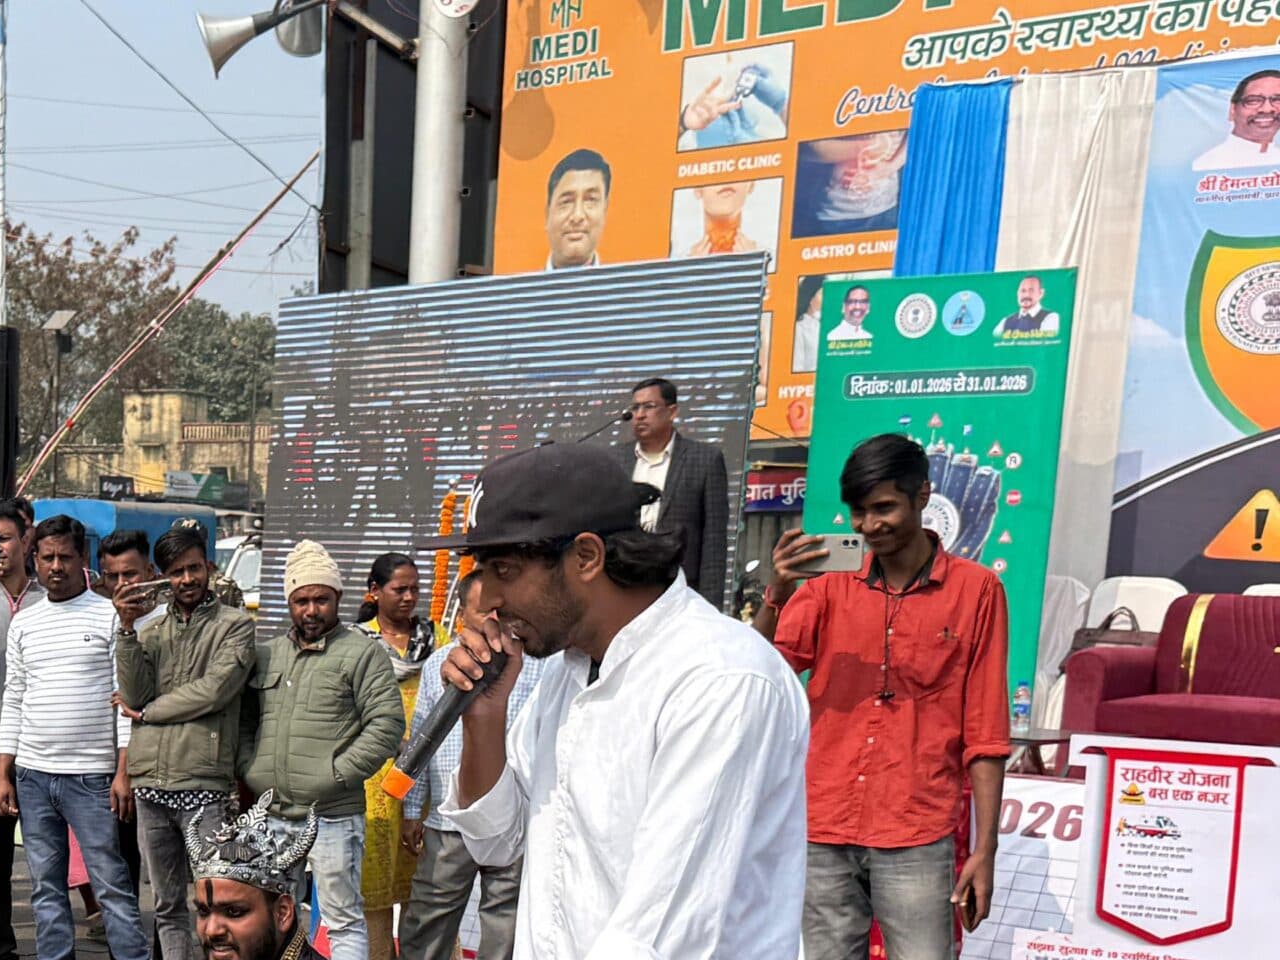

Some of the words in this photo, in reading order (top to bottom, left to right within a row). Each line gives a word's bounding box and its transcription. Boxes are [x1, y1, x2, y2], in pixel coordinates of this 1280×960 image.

[531, 28, 597, 62] MEDI
[904, 12, 1012, 67] आपके
[516, 59, 611, 90] HOSPITAL
[678, 159, 735, 177] DIABETIC
[737, 153, 782, 170] CLINIC
[801, 243, 855, 260] GASTRO
[967, 374, 1028, 392] 31.01.2026
[1120, 765, 1175, 786] राहवीर
[1177, 767, 1232, 789] योजना
[1148, 787, 1170, 801] बस
[1172, 789, 1194, 802] एक
[998, 798, 1085, 842] 026
